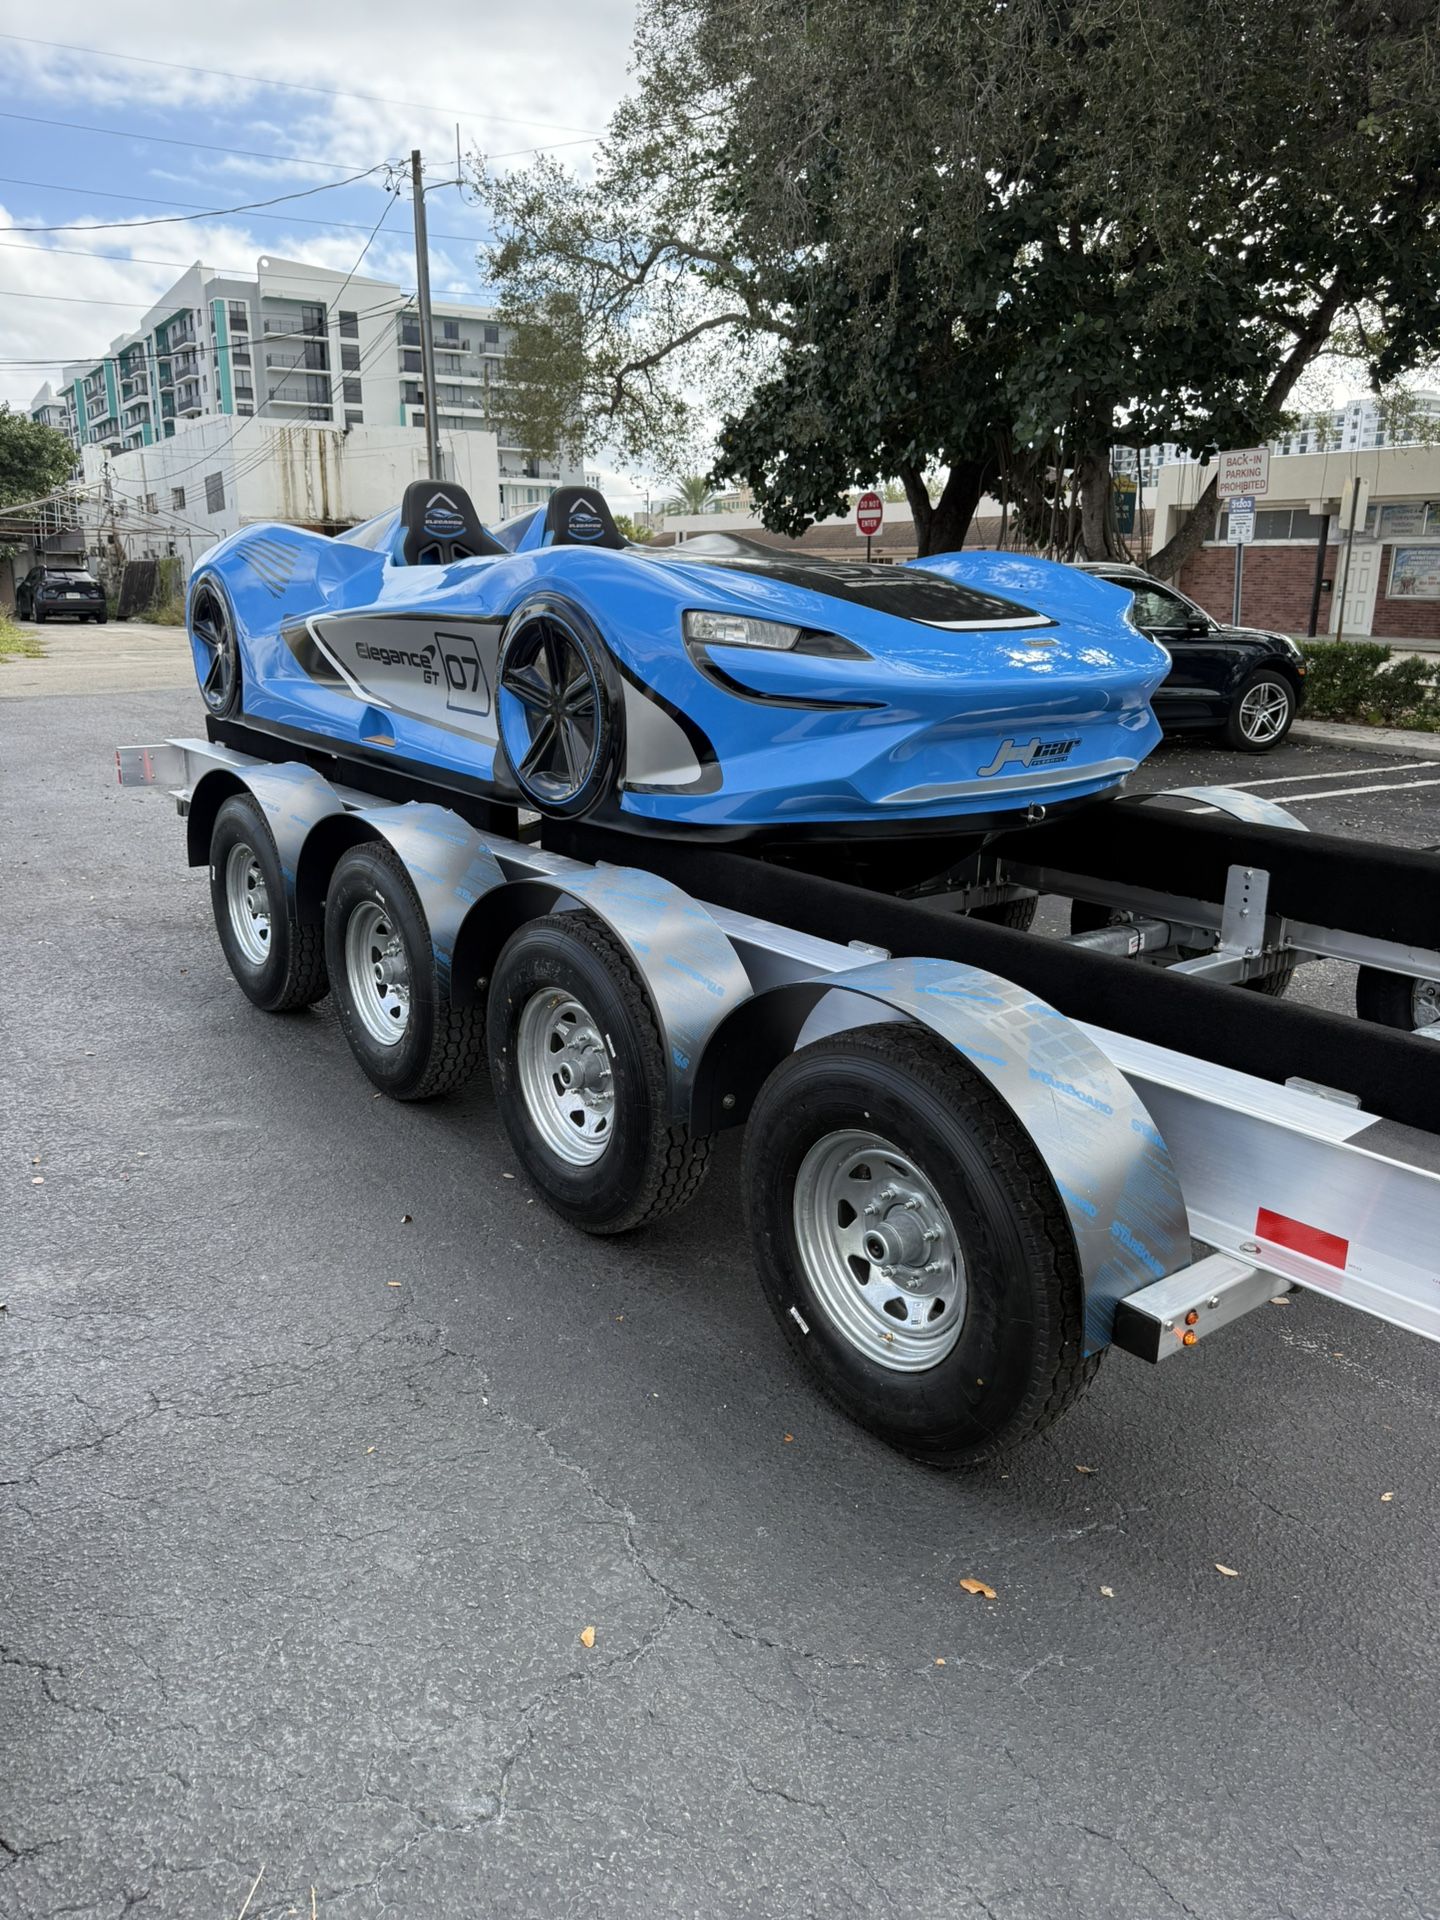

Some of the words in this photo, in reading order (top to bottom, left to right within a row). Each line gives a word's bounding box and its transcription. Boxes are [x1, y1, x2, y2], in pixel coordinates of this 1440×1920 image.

[1226, 455, 1263, 467] BACK-IN
[1226, 467, 1261, 479] PARKING
[1220, 480, 1266, 492] PROHIBITED
[860, 500, 867, 508] DO
[869, 500, 880, 508] NOT
[355, 642, 432, 669] Elegance
[423, 670, 440, 686] GT
[446, 654, 479, 692] 07
